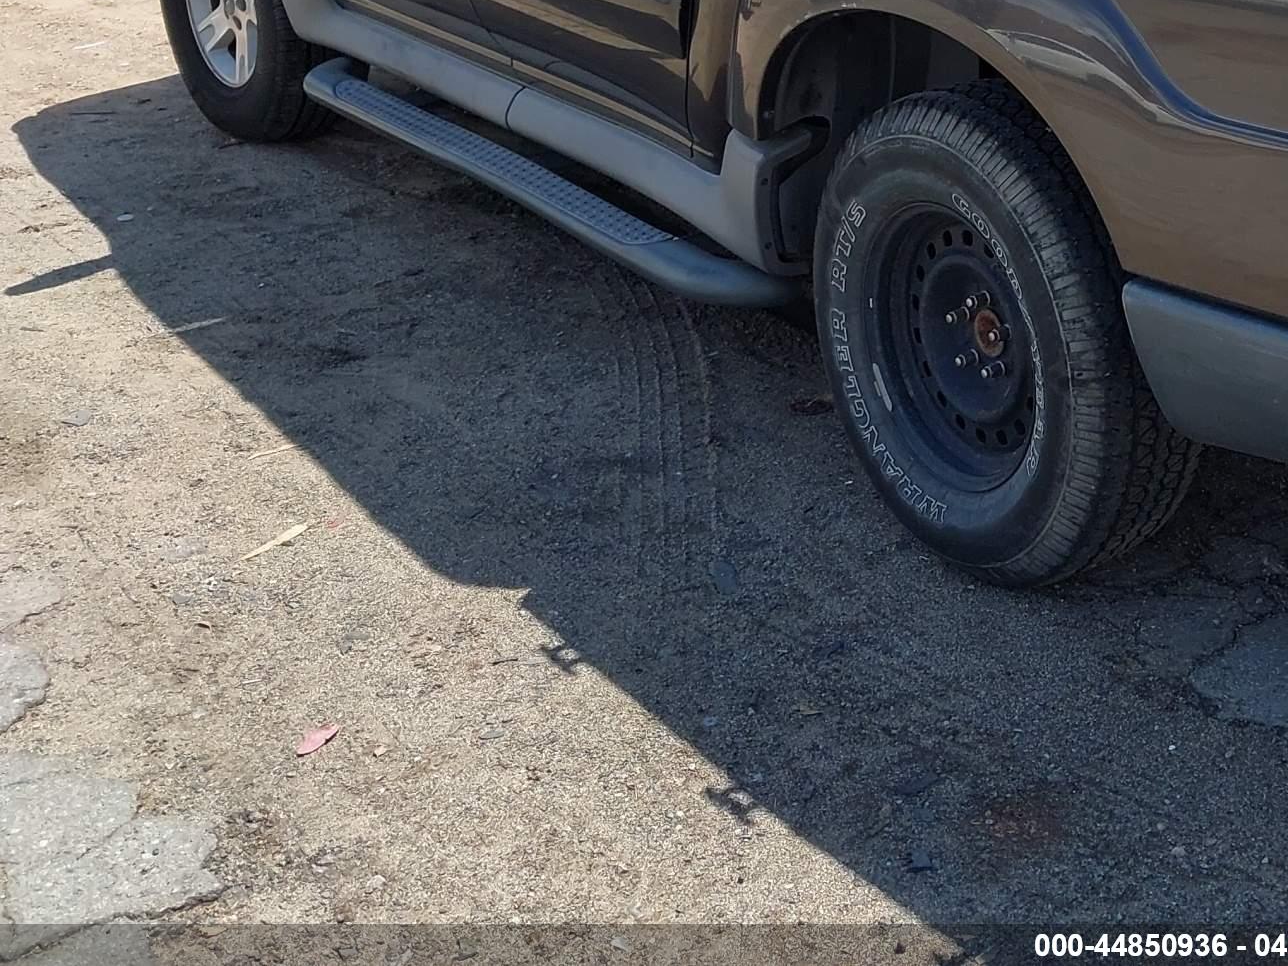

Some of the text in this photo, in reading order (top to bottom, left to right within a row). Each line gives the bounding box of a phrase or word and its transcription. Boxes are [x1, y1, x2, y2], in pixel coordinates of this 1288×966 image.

[830, 199, 947, 523] WRANGLER RT/S
[951, 193, 1045, 478] GOODYEAR
